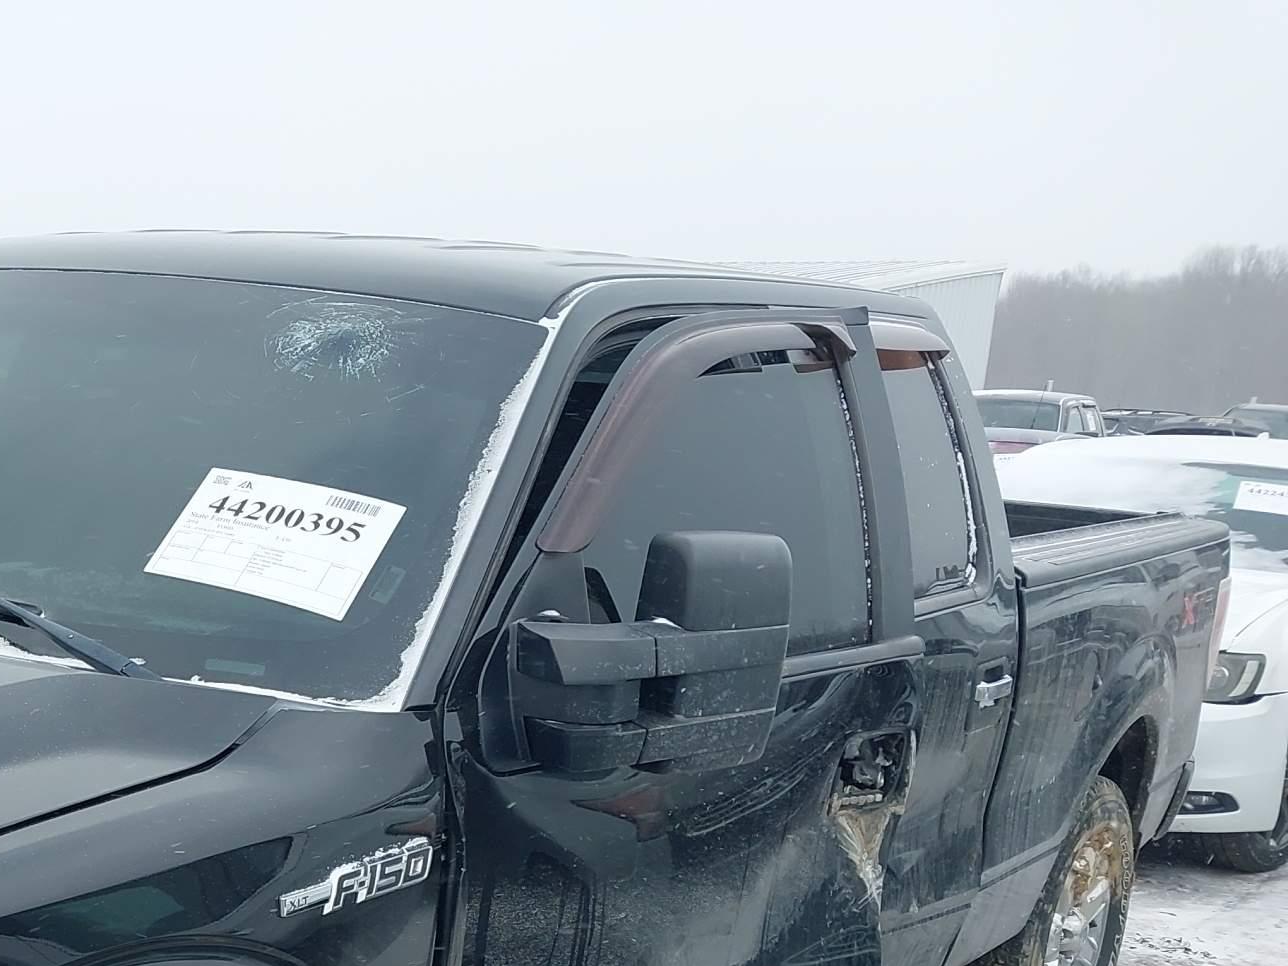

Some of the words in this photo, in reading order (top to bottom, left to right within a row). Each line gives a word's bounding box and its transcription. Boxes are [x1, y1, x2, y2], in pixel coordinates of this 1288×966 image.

[1248, 488, 1288, 498] 44224
[208, 494, 367, 544] 44200395
[288, 895, 310, 912] XLT
[322, 845, 434, 915] F-150
